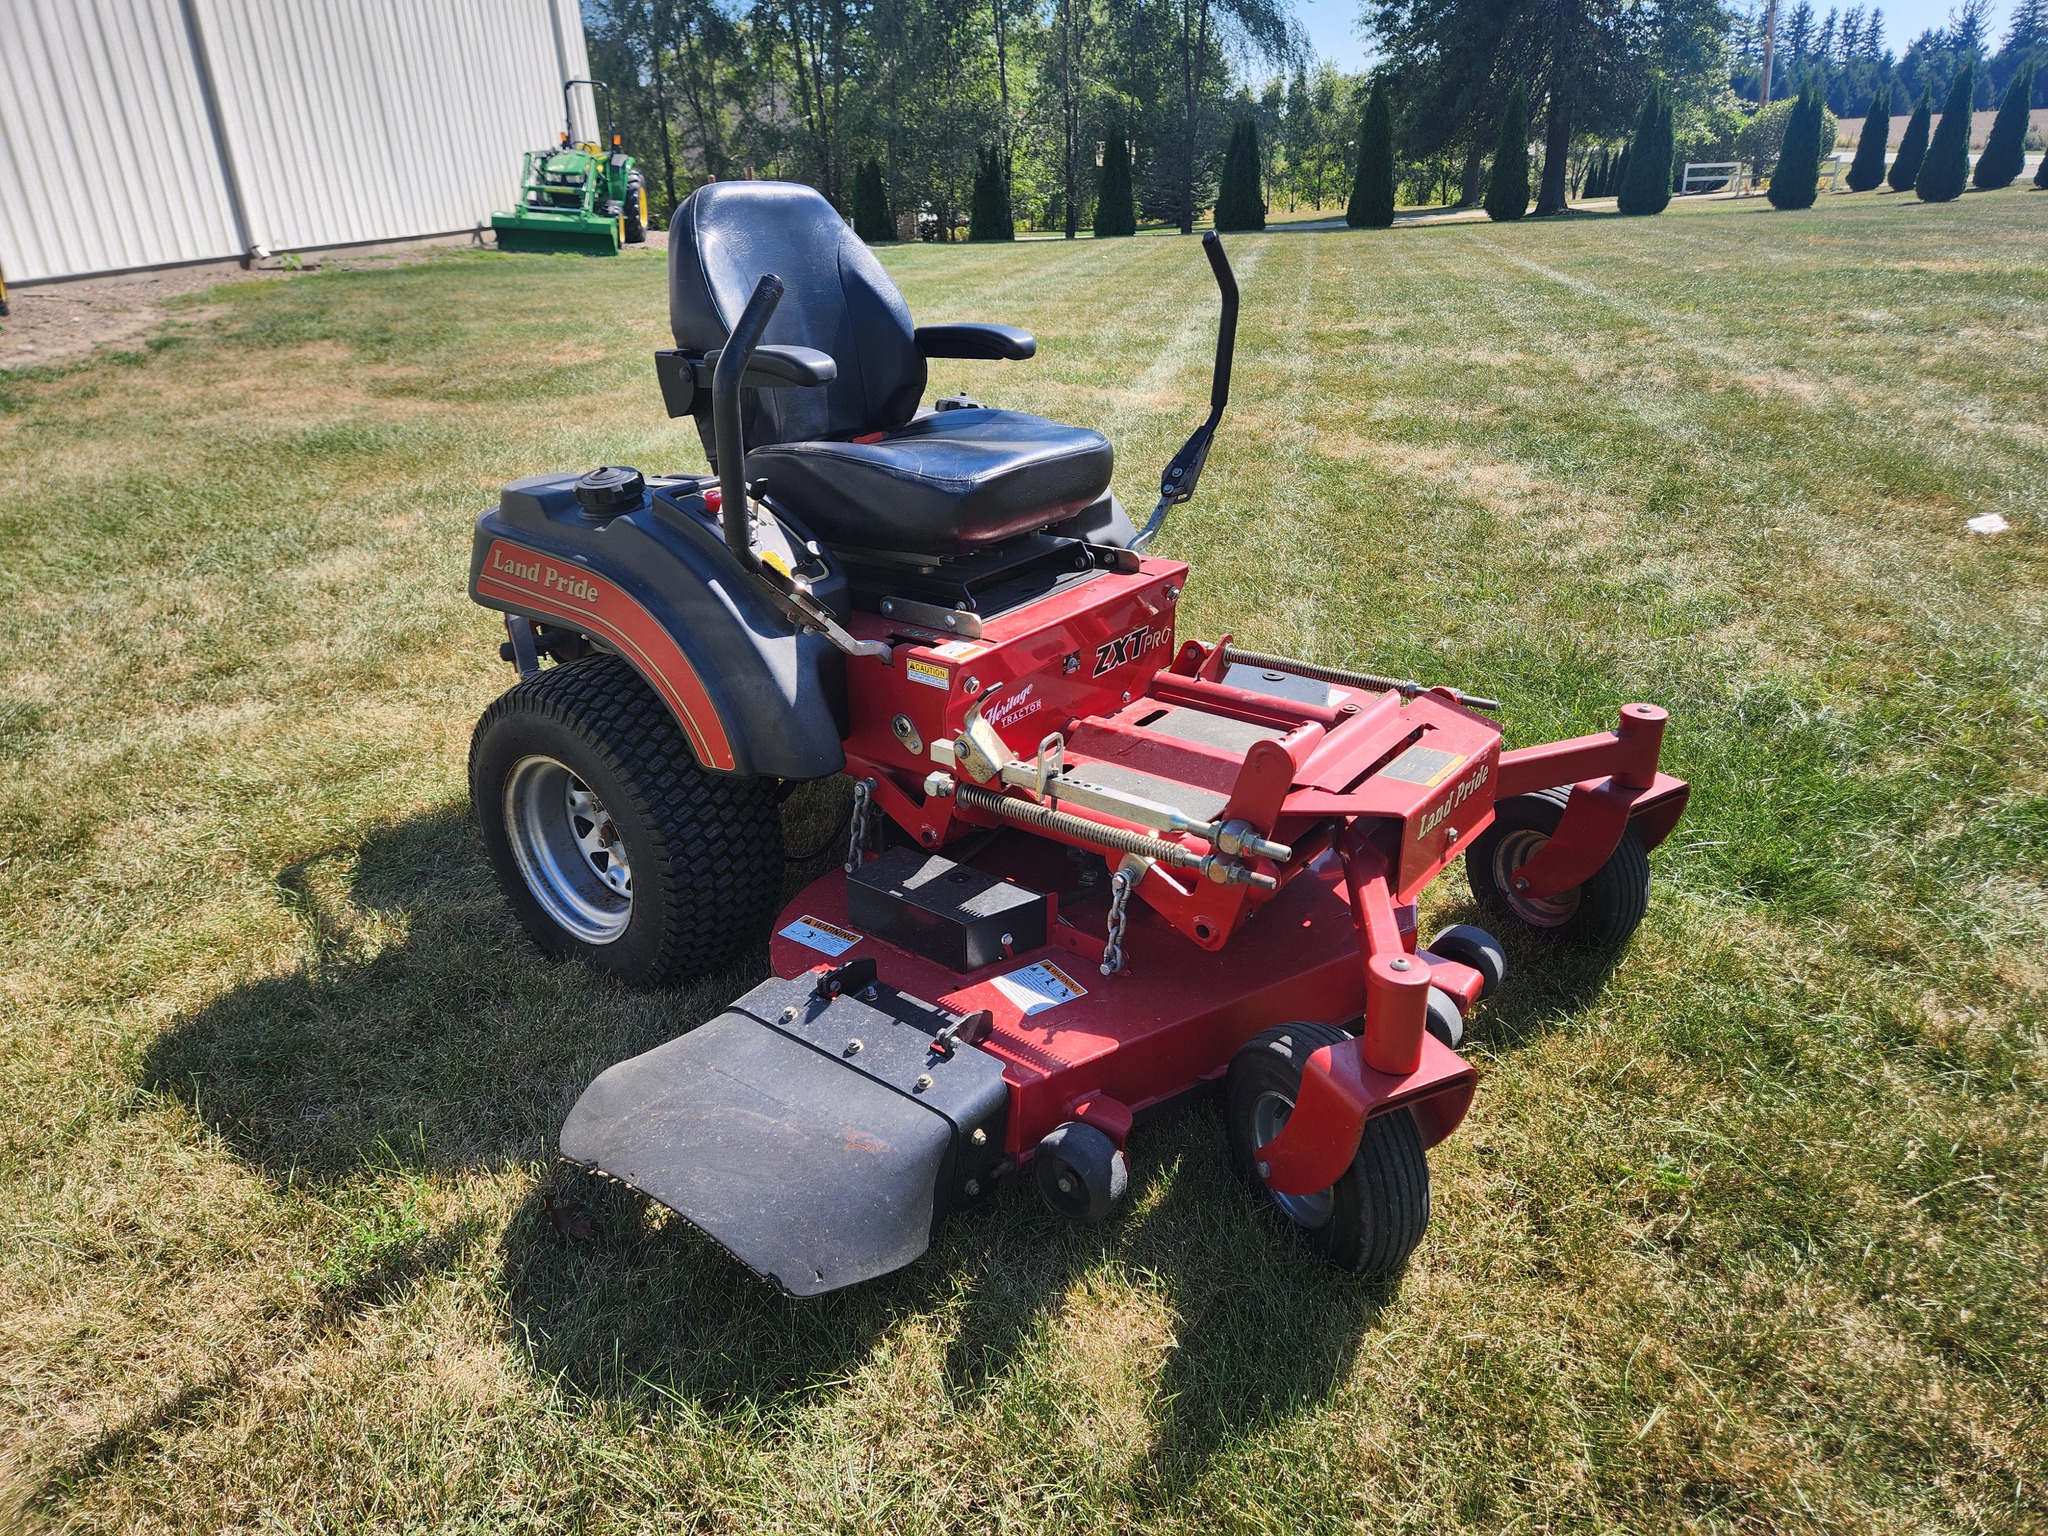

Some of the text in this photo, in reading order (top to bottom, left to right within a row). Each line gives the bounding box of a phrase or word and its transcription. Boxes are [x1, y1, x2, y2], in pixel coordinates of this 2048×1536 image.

[492, 549, 599, 603] Land Pride
[1092, 625, 1171, 679] ZXT PRO
[915, 663, 946, 677] CAUTION
[984, 683, 1033, 726] Heritage
[1001, 701, 1042, 727] TRACTOR
[1417, 790, 1454, 841] Land
[1454, 764, 1489, 808] Pride
[813, 921, 856, 942] WARNING
[1050, 968, 1082, 993] WARNING
